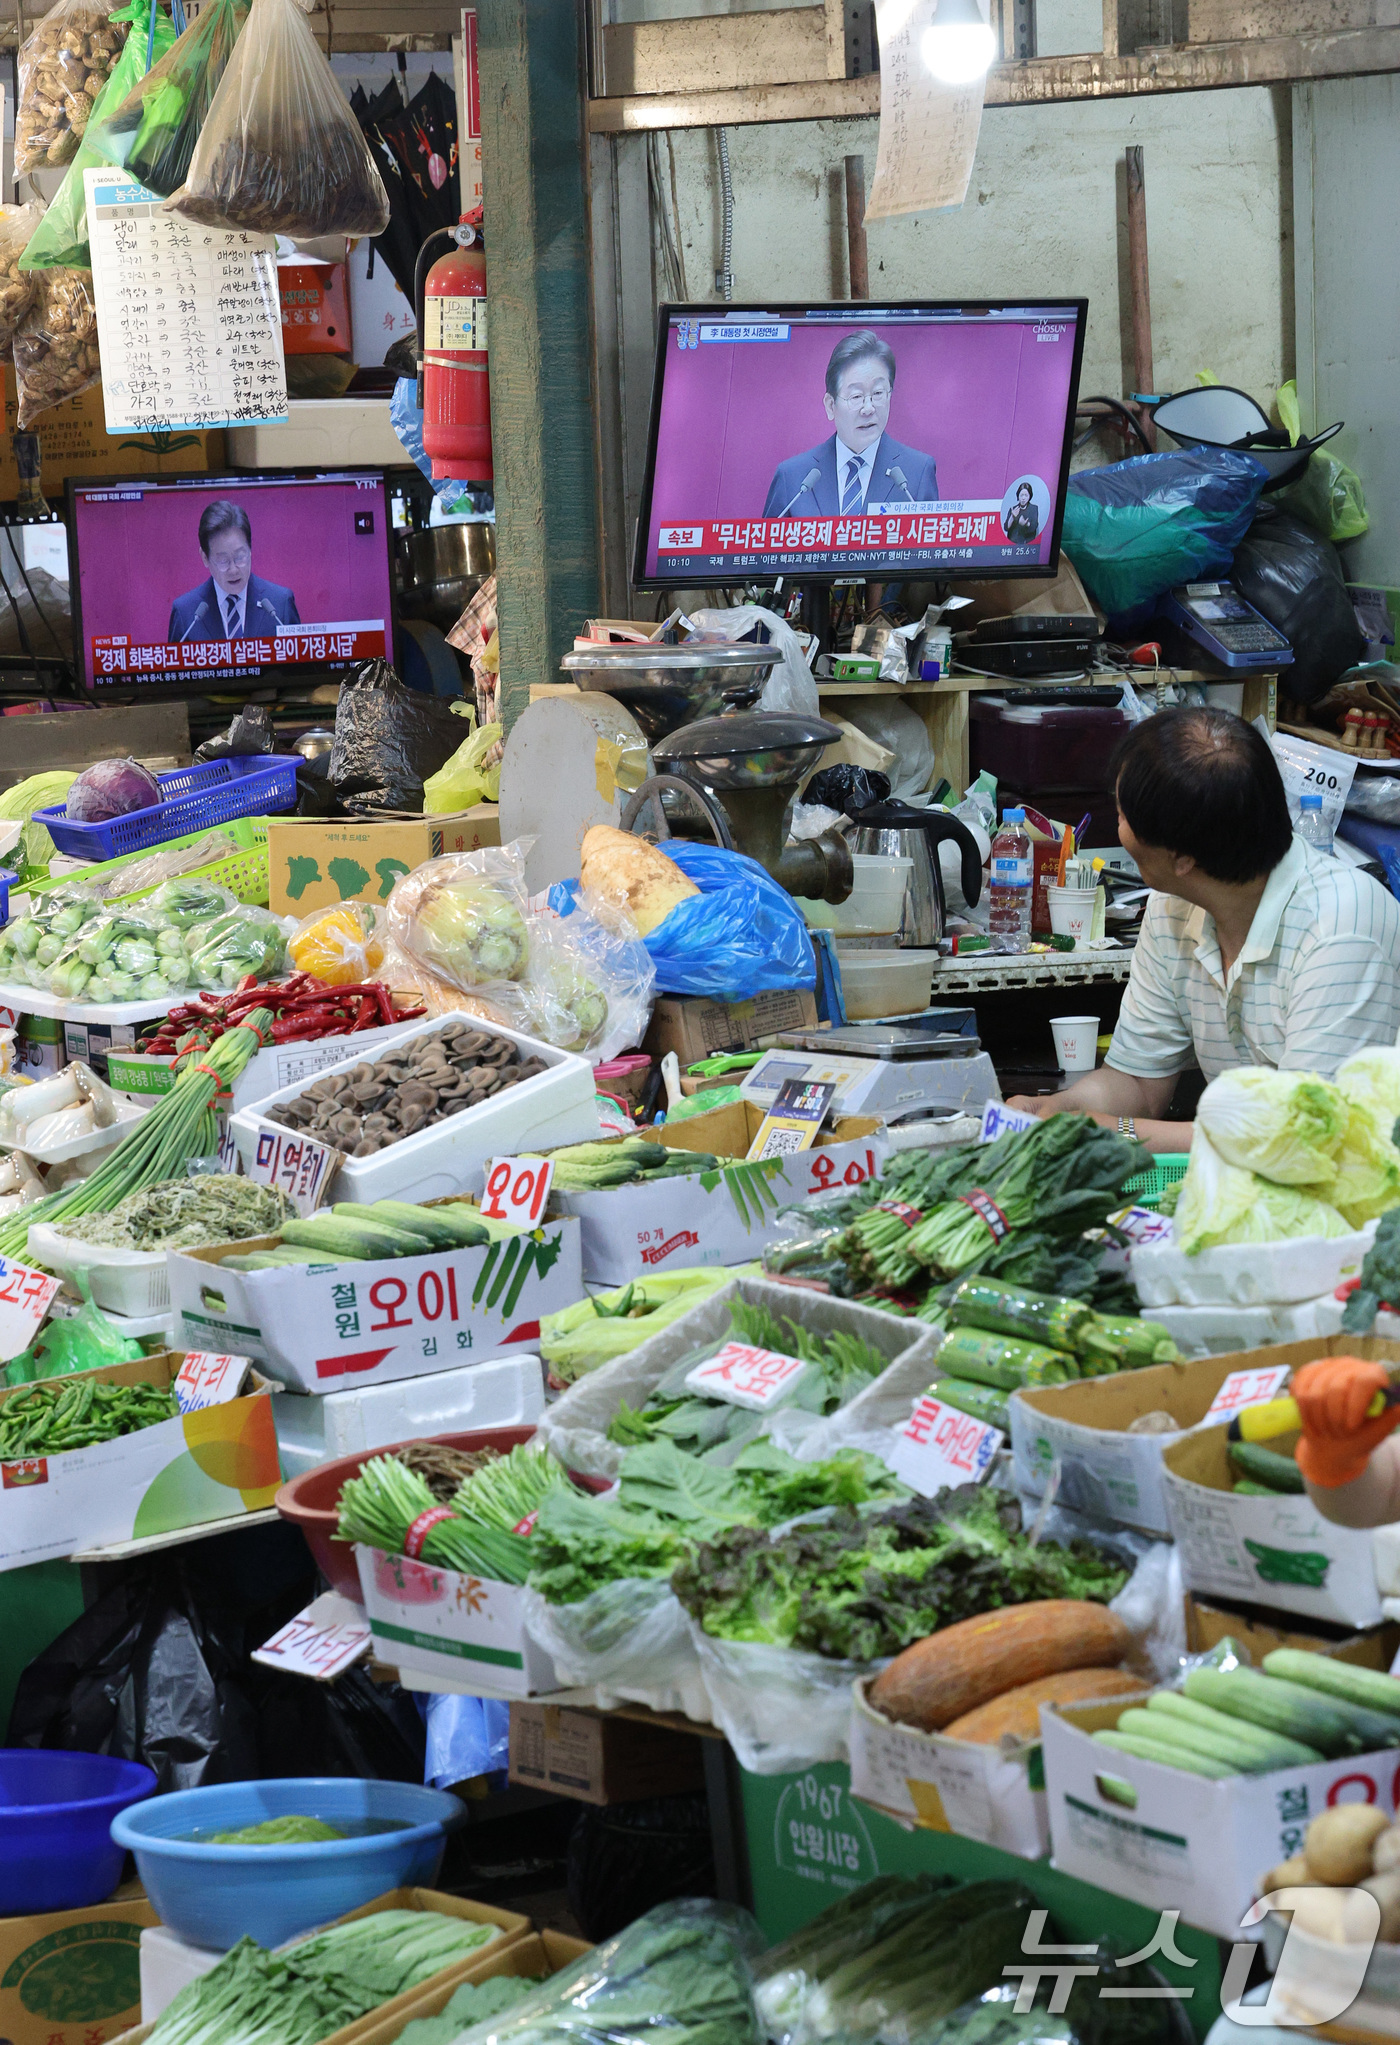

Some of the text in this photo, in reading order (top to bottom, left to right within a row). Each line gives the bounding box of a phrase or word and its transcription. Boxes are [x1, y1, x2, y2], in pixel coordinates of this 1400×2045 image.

[720, 327, 741, 338] 대통령
[743, 327, 751, 338] 첫
[752, 327, 779, 337] 시정연설
[1032, 325, 1067, 334] CHOSUN
[356, 481, 377, 490] YTN
[903, 504, 917, 512] 시각
[920, 503, 933, 512] 국회
[935, 502, 964, 511] 본회의장
[668, 530, 694, 546] 속보
[769, 519, 834, 548] 민생경제
[834, 518, 883, 547] 살리는
[885, 518, 904, 545] 일,
[906, 516, 956, 544] 시급한
[667, 557, 690, 567] 10:10
[709, 556, 724, 567] 국제
[832, 552, 848, 562] 보도
[934, 549, 958, 559] 유출자
[129, 645, 180, 670] 회복하고
[182, 641, 232, 667] 민생경제
[233, 638, 271, 664] 살리는
[274, 637, 299, 661] 일이
[301, 634, 327, 659] 가장
[1303, 767, 1338, 789] 200
[1064, 1051, 1077, 1060] king
[129, 1069, 149, 1087] 강낭콩
[808, 1149, 877, 1195] 오이
[480, 1162, 551, 1220] 오이
[637, 1227, 665, 1244] 50 개
[651, 1232, 689, 1263] CUCUMBER
[368, 1266, 460, 1333] 오이
[903, 1397, 987, 1473] 로메인
[795, 1774, 843, 1821] 1967
[788, 1818, 860, 1871] 인왕시장
